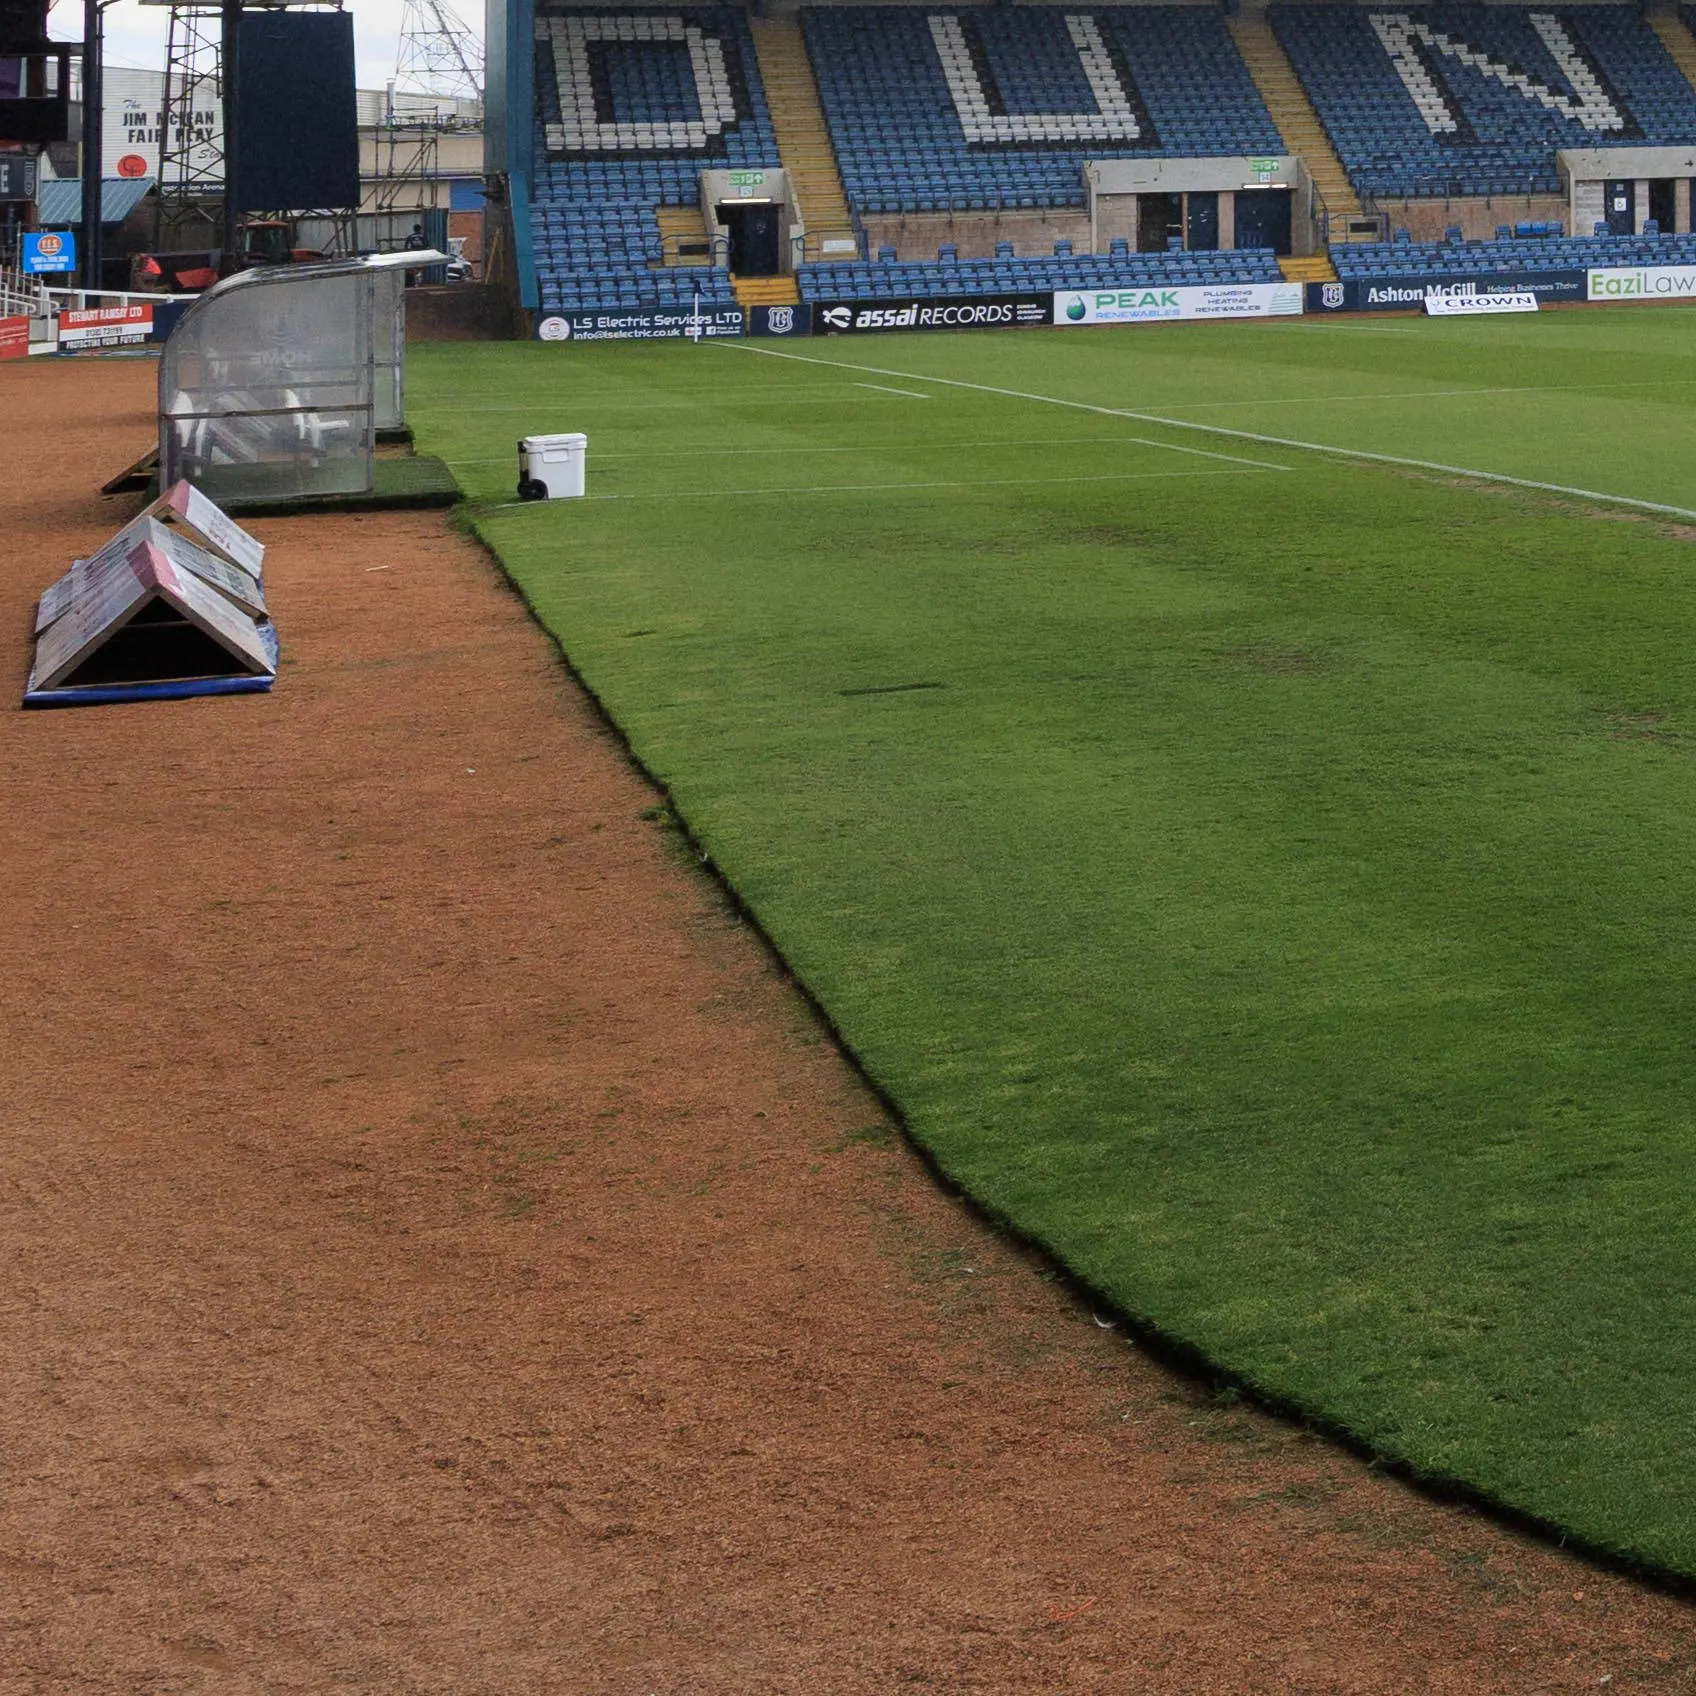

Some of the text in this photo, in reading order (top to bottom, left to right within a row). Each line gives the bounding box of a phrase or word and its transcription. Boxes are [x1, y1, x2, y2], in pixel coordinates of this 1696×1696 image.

[122, 112, 147, 126] JIM
[1368, 282, 1476, 303] Ashton McGill
[1096, 291, 1180, 309] PEAK
[1445, 296, 1531, 307] CROWN
[129, 306, 142, 317] LTD
[856, 304, 1013, 328] assai RECORDS
[1095, 309, 1180, 319] RENEWABLES
[1195, 305, 1260, 313] RENEWABLES
[573, 312, 742, 329] LS Electric Services LTD
